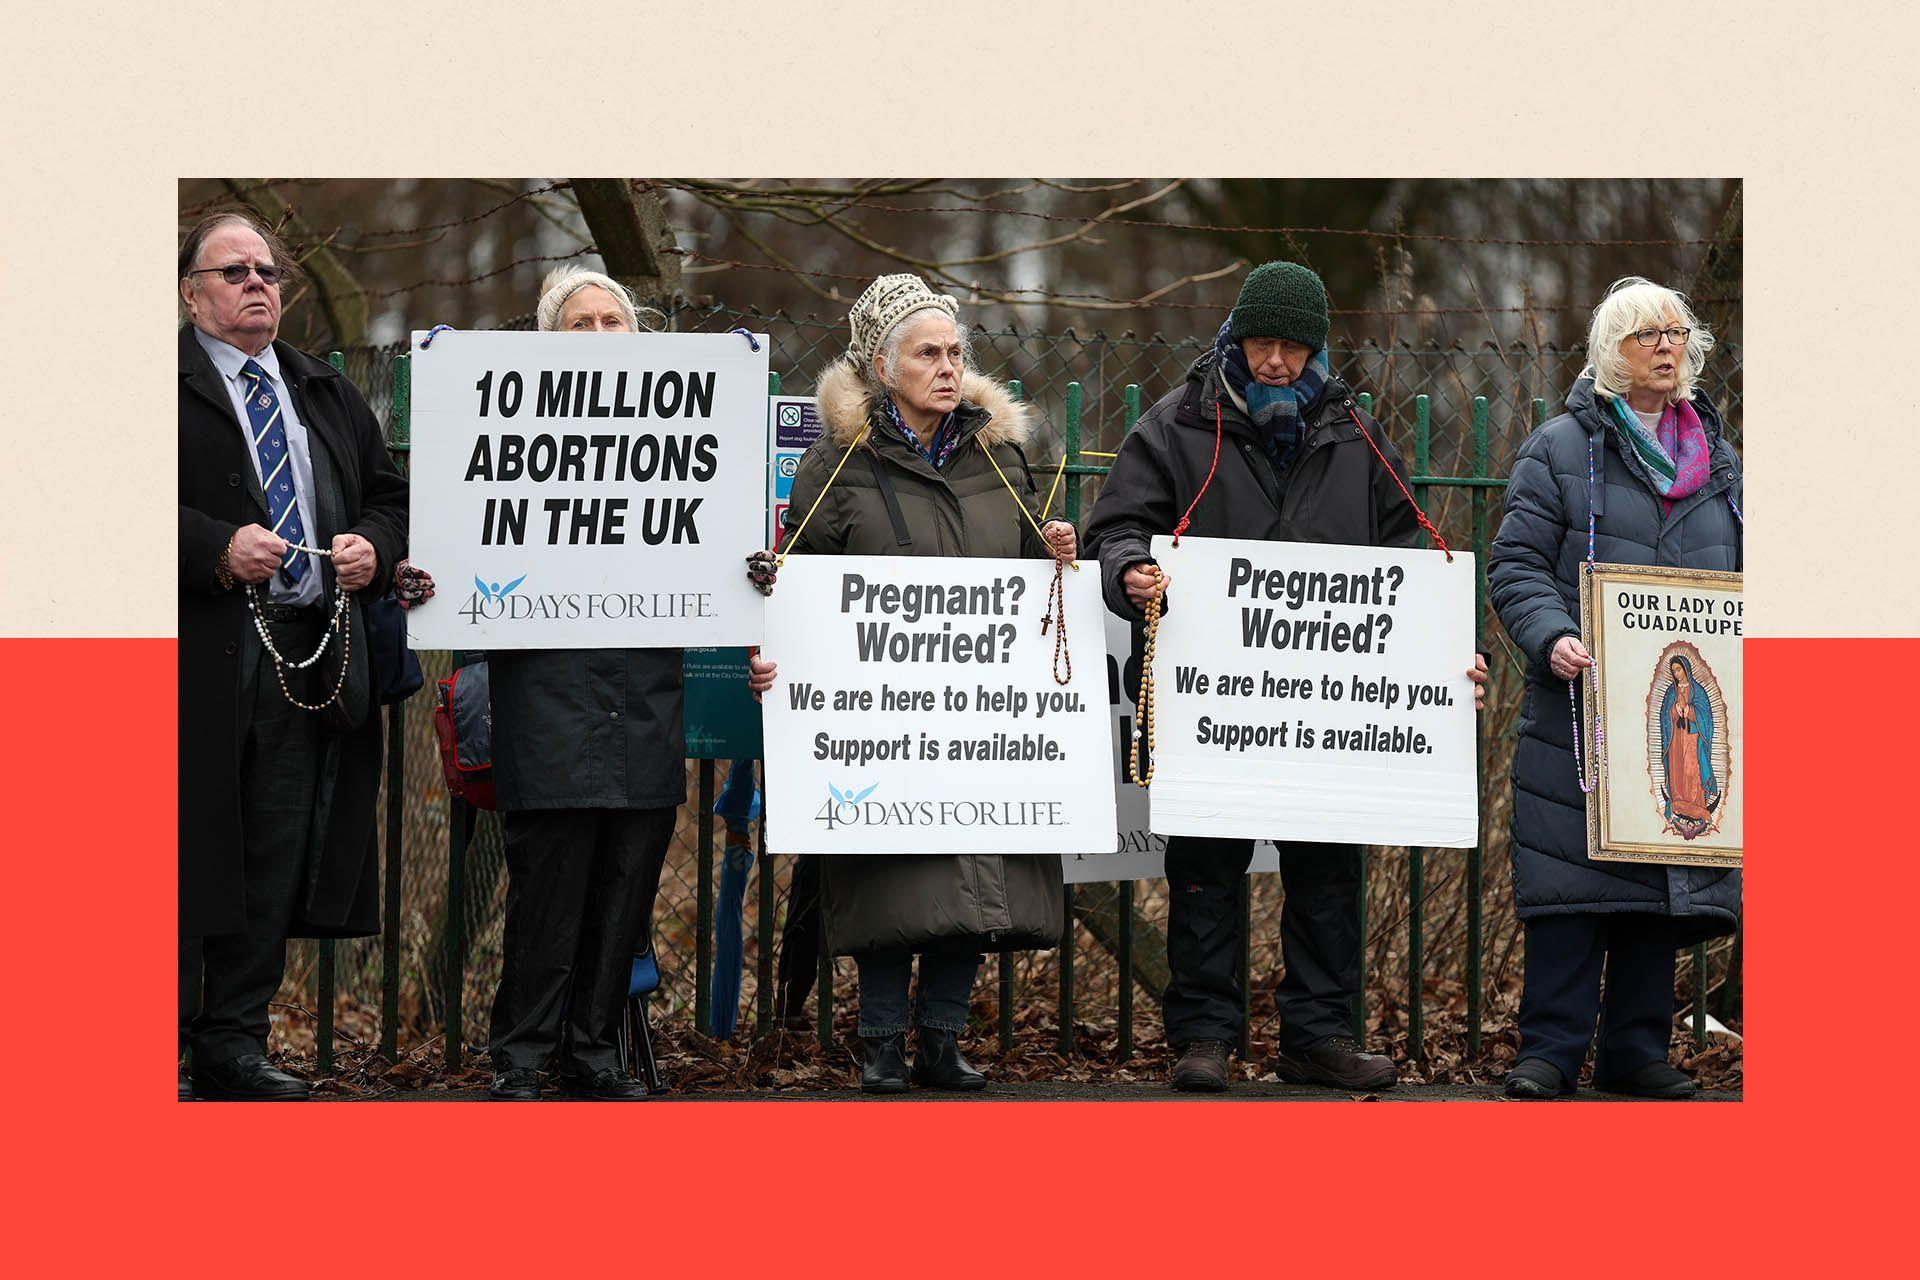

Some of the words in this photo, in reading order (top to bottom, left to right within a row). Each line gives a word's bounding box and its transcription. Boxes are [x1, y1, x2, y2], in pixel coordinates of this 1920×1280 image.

[476, 370, 524, 419] 10
[536, 370, 717, 419] MILLION
[464, 434, 719, 483] ABORTIONS
[481, 498, 529, 546] IN
[543, 498, 628, 546] THE
[642, 497, 704, 546] UK
[840, 573, 1026, 624] Pregnant?
[1228, 557, 1405, 611] Pregnant?
[1617, 591, 1660, 611] OUR
[1666, 595, 1716, 615] LADY
[458, 591, 506, 625] 40
[510, 593, 581, 619] DAYS
[587, 593, 649, 619] FOR
[652, 593, 713, 618] LIFE
[1622, 611, 1743, 637] GUADALUPE
[856, 621, 1017, 664] Worried?
[1242, 606, 1393, 655] Worried?
[788, 682, 826, 712] We
[832, 689, 873, 712] are
[880, 683, 936, 712] here
[943, 685, 968, 712] to
[975, 684, 1028, 719] help
[1035, 689, 1086, 719] you.
[1175, 665, 1210, 695] We
[1216, 674, 1255, 698] are
[1261, 669, 1314, 700] here
[1320, 673, 1344, 702] to
[1350, 674, 1400, 710] help
[1406, 684, 1454, 711] you.
[813, 731, 912, 767] Support
[918, 732, 940, 761] is
[947, 732, 1066, 762] available.
[1196, 715, 1289, 753] Support
[1295, 720, 1316, 749] is
[1321, 723, 1433, 755] available.
[814, 796, 861, 831] 40
[864, 801, 934, 827] DAYS
[939, 801, 1001, 827] FOR
[1003, 801, 1064, 826] LIFE
